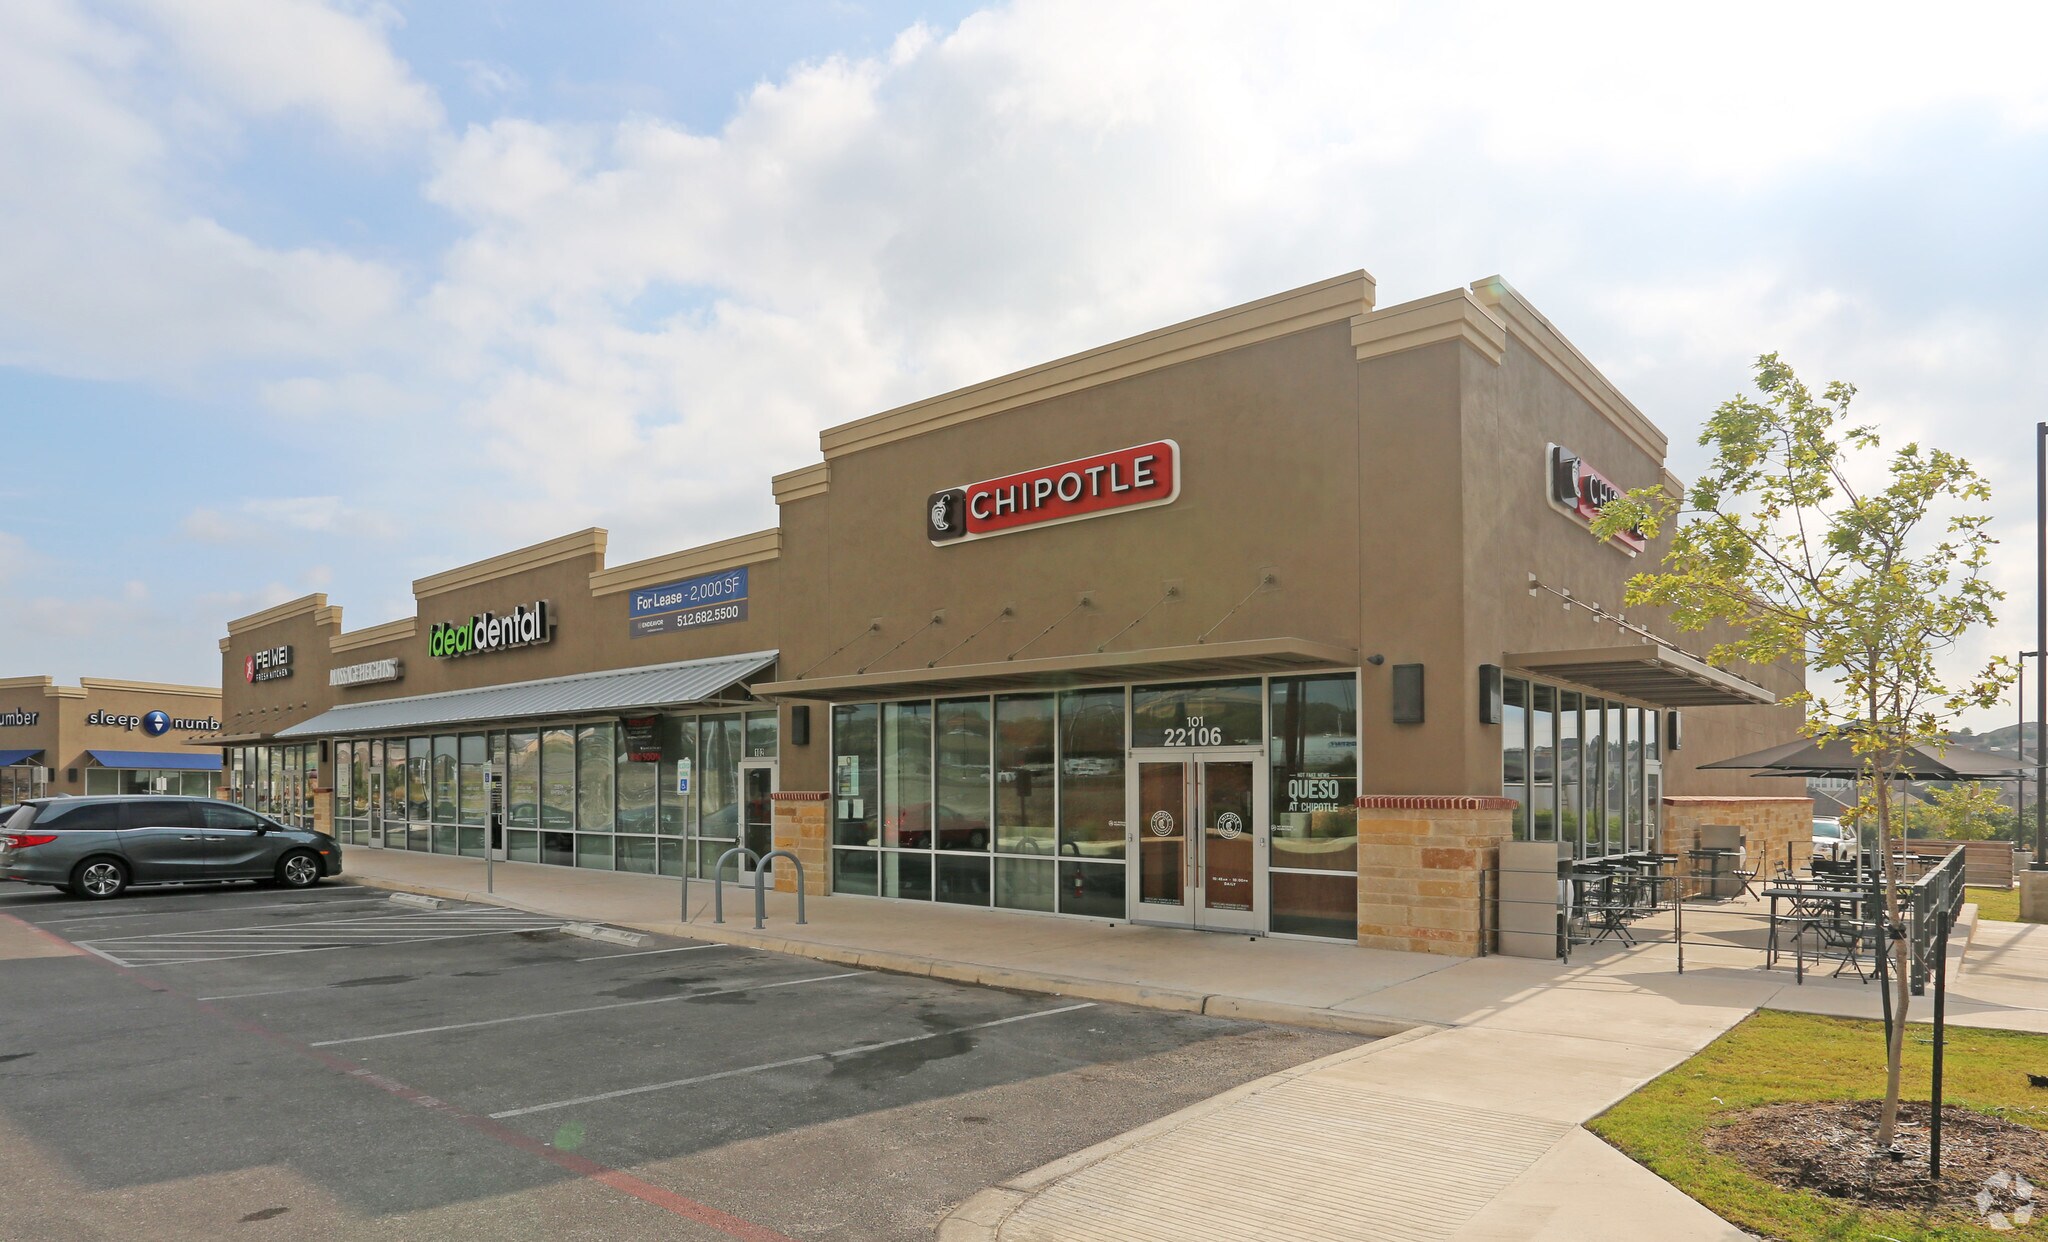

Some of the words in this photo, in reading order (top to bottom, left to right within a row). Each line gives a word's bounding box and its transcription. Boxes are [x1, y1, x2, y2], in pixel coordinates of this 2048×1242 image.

[970, 454, 1154, 519] CHIPOTLE
[637, 596, 652, 610] For
[654, 592, 682, 607] Lease
[690, 581, 722, 602] 2,000
[724, 576, 739, 594] SF
[677, 605, 739, 627] 512.682.5500
[89, 710, 140, 730] sleep
[174, 717, 222, 730] numb
[1187, 716, 1204, 727] 101
[1164, 727, 1222, 746] 22106
[1288, 779, 1339, 802] QUESO
[1288, 802, 1299, 812] AT
[1301, 802, 1339, 813] CHIPOTLE
